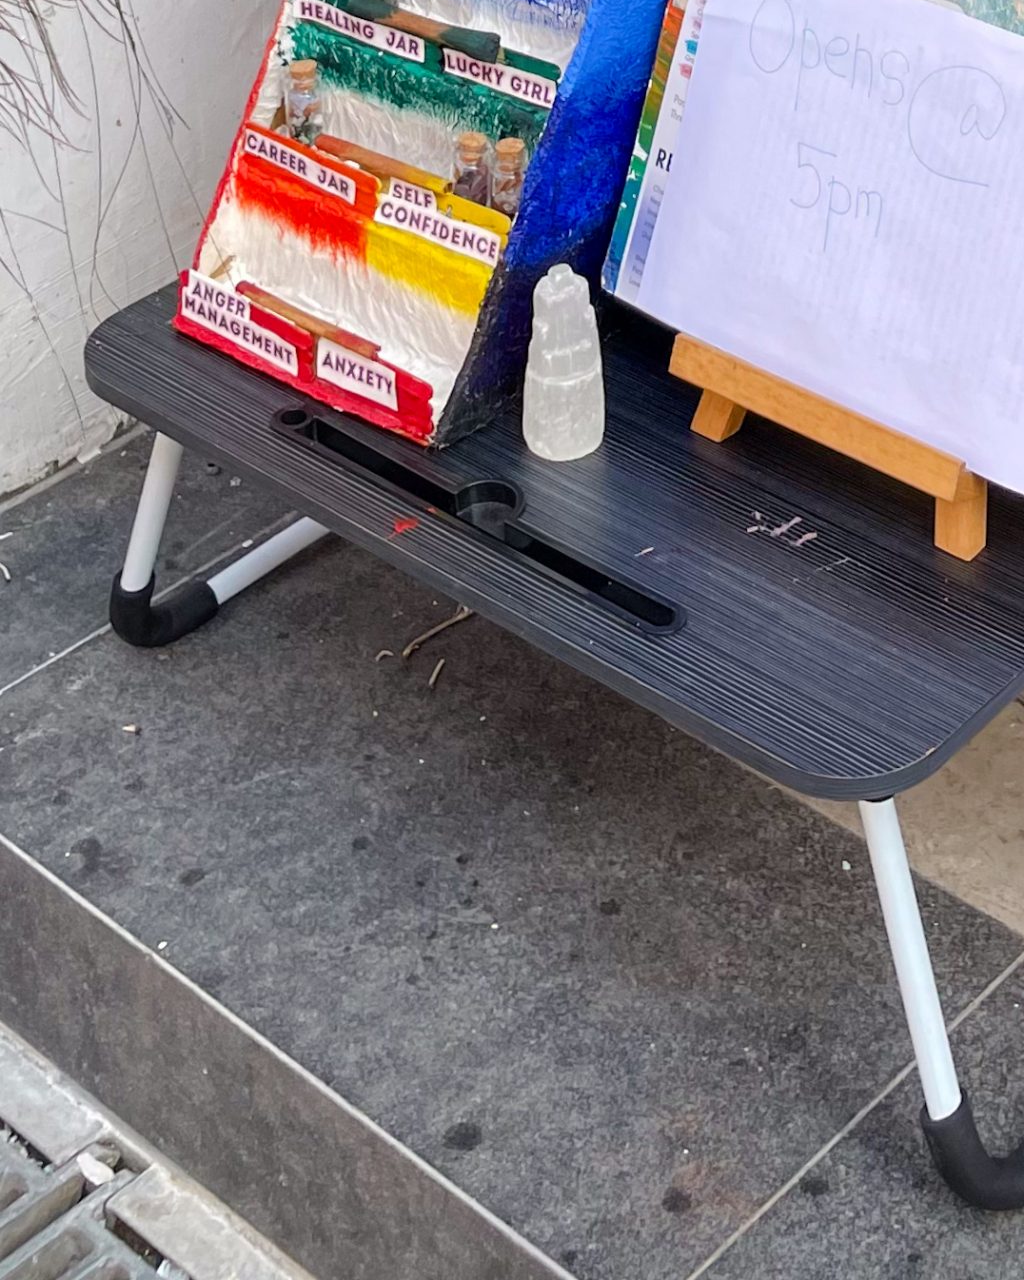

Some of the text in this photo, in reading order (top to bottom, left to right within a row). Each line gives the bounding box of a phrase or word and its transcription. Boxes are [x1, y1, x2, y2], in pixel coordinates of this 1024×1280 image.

[301, 1, 419, 56] HEALING JAR
[446, 54, 552, 104] LUCKY GIRL
[246, 134, 349, 198] CAREER JAR
[393, 183, 433, 209] SELF
[380, 201, 497, 260] CONFIDENCE
[191, 280, 247, 319] ANGER
[183, 295, 293, 366] MANAGEMENT
[321, 351, 394, 395] ANXIETY
